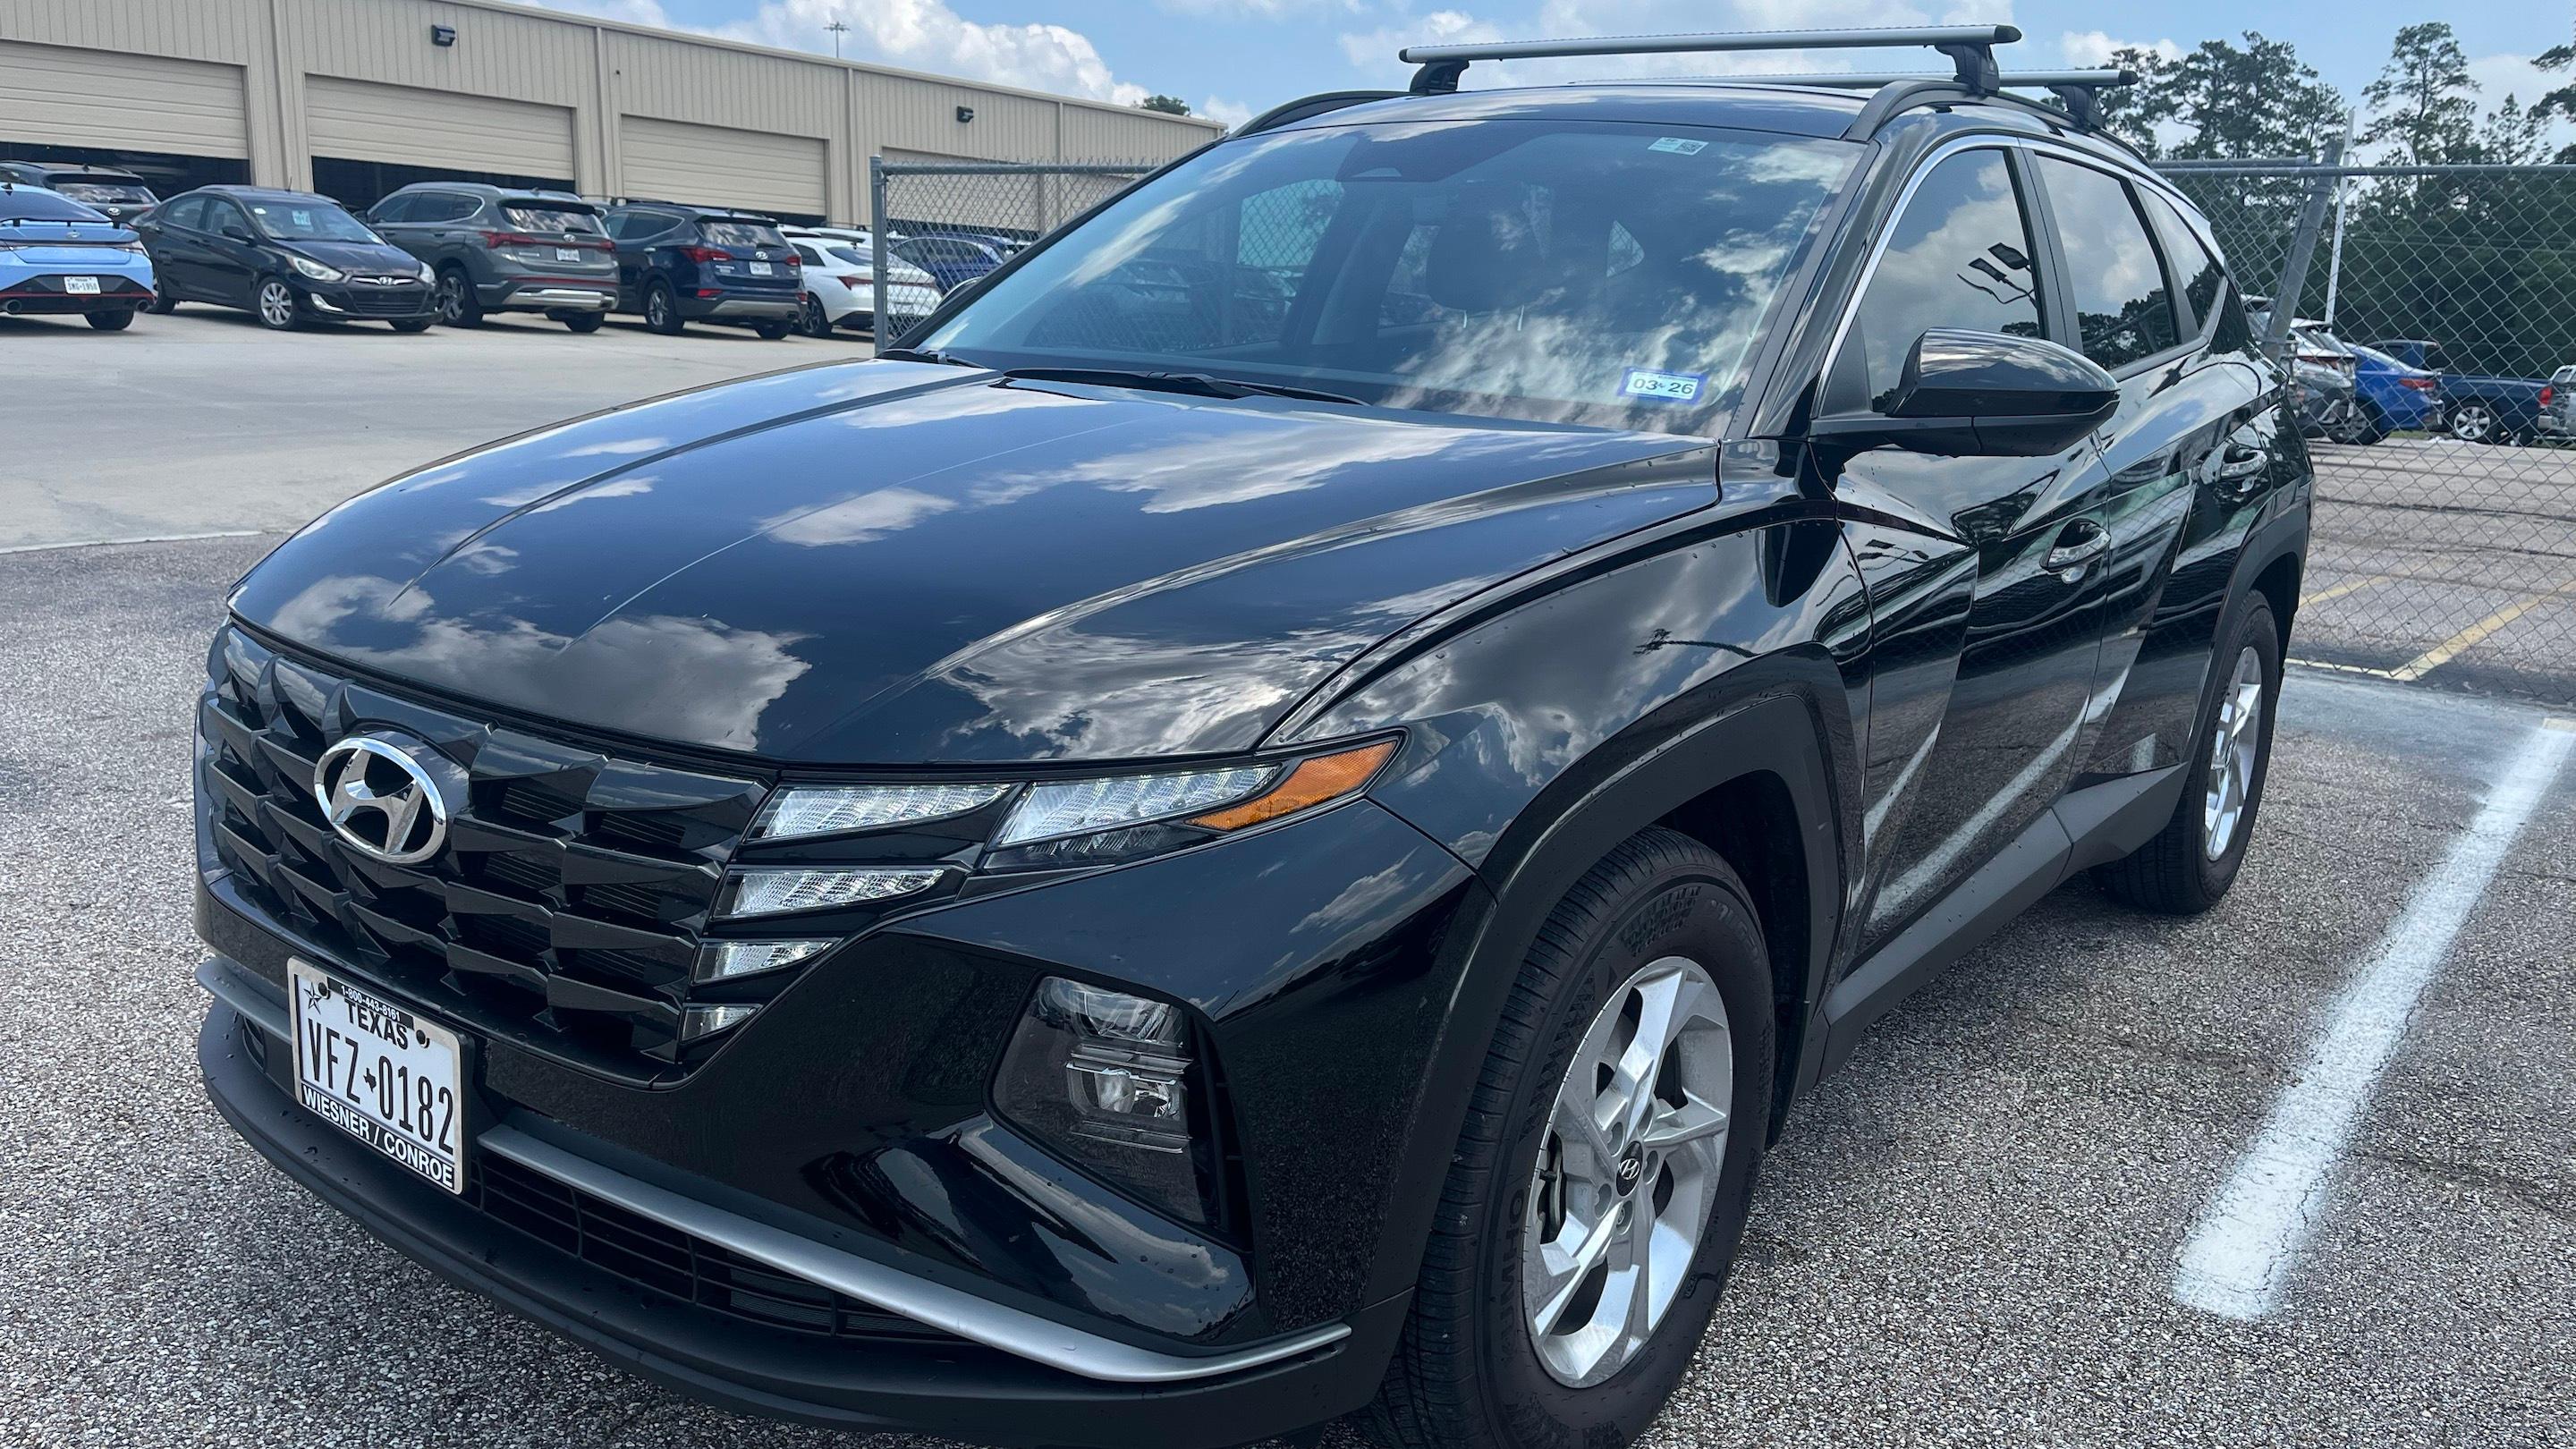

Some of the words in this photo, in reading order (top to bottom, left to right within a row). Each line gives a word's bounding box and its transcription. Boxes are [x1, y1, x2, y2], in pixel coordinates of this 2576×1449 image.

[341, 985, 401, 1021] 1-800-443-8161
[344, 997, 409, 1050] TEXAS
[302, 1086, 369, 1140] WIESNER
[384, 1134, 453, 1188] CONROE
